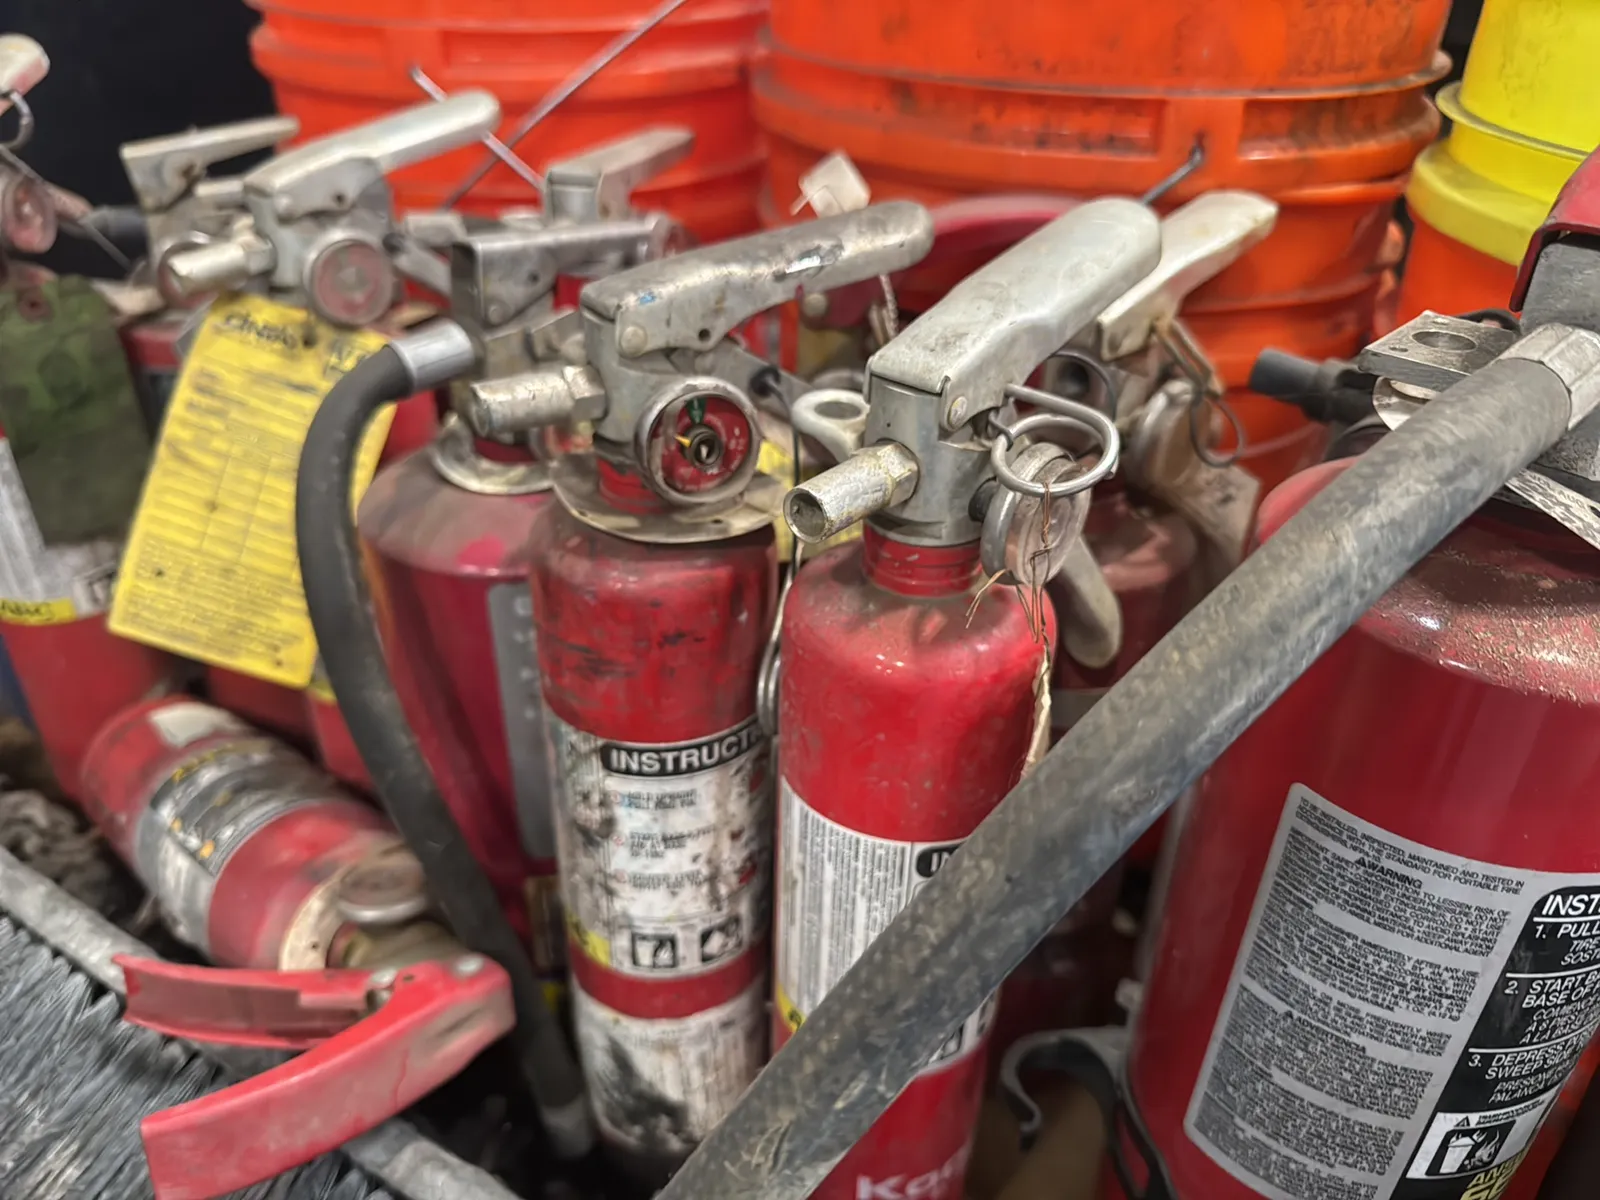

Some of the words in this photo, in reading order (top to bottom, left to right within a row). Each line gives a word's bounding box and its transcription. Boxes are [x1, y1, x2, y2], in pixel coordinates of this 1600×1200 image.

[1366, 861, 1423, 889] WARNING
[1368, 845, 1384, 857] THE
[1385, 853, 1431, 874] STANDARD
[1433, 870, 1452, 880] FOR
[1453, 875, 1499, 892] PORTABLE
[1408, 853, 1459, 874] MAINTAINED
[1460, 870, 1479, 879] AND
[1482, 874, 1513, 887] TESTED
[1422, 893, 1436, 902] TO
[1541, 893, 1600, 916] INST
[1534, 923, 1547, 939] 1.
[1556, 920, 1600, 939] PULL
[1504, 979, 1519, 995] 2.
[1528, 973, 1586, 994] START
[1521, 990, 1571, 1008] BASE
[1571, 983, 1595, 1001] OF
[1468, 1054, 1482, 1068] 3.
[1491, 1041, 1566, 1067] DEPRESS
[1485, 1059, 1544, 1080] SWEEP
